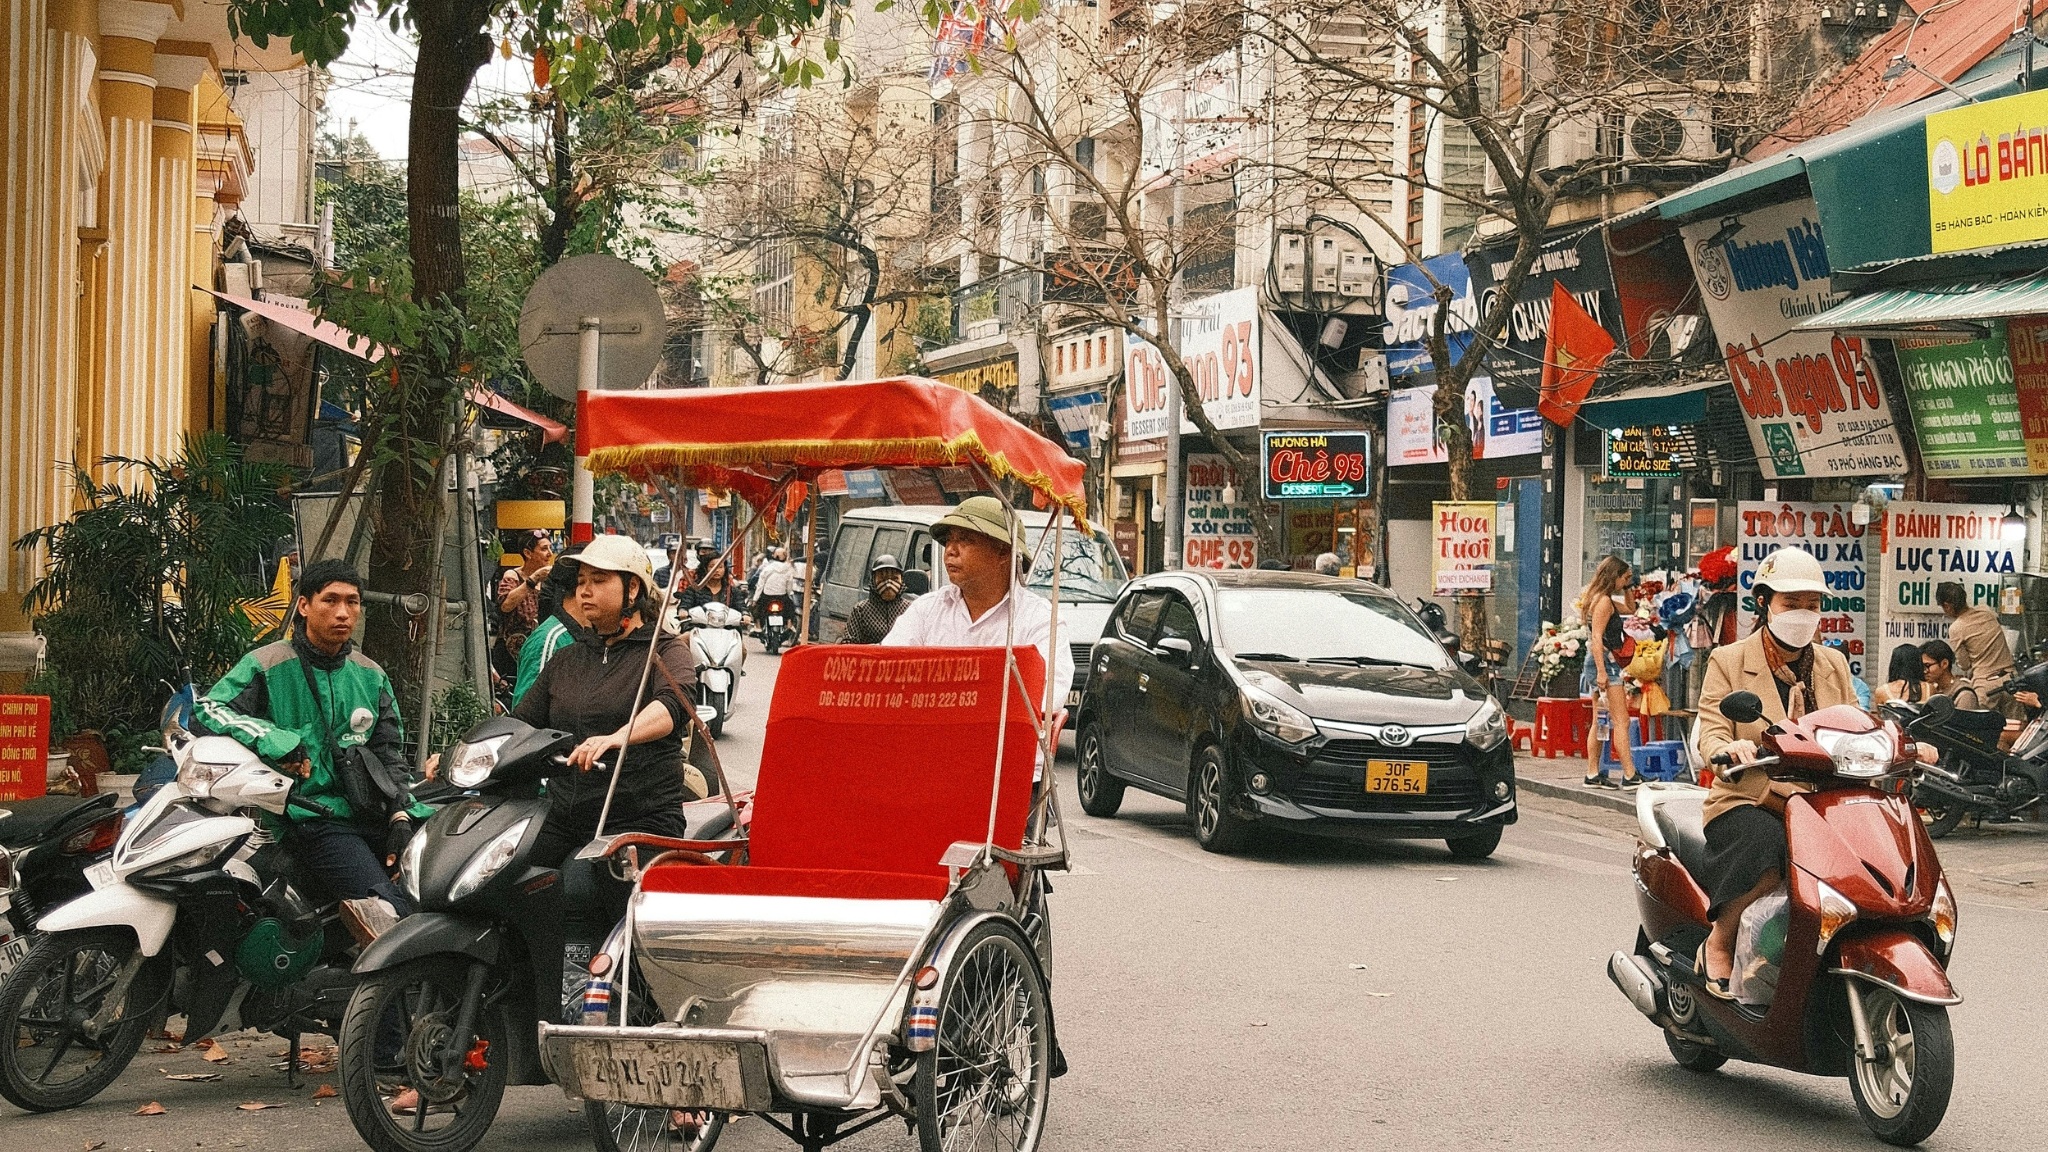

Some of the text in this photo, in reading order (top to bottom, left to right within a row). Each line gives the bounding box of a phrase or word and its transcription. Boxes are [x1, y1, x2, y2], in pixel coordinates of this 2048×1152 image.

[1963, 122, 2048, 187] LÒ BÁN
[1935, 221, 1947, 232] 95
[1948, 216, 1973, 230] HÀNG
[1975, 214, 1993, 228] BẠC
[1999, 207, 2027, 222] HOÀN
[1129, 347, 1166, 413] Chè
[1222, 320, 1254, 398] 93
[1906, 342, 2014, 391] CHÈ NGON PHỐ CỔ
[1726, 333, 1880, 434] Chè ngon 93
[1131, 416, 1169, 436] DESSERT SHO
[1270, 434, 1327, 448] HƯƠNG HẢI
[1612, 441, 1628, 453] KIM
[1189, 460, 1224, 487] TRÔI
[1270, 449, 1331, 483] Chè
[1334, 453, 1365, 481] 93
[1633, 456, 1651, 471] CÁC
[1652, 459, 1671, 471] SIZE
[1828, 454, 1903, 471] 93 PHỐ HÀNG BẠC
[1189, 489, 1211, 504] LỤC
[1281, 483, 1324, 495] DESSERT
[1187, 505, 1249, 519] CHÍ MÀ PH
[1439, 511, 1490, 534] Hoa
[1742, 503, 1866, 538] TRÔI TÀU
[1191, 519, 1218, 534] XÔI
[1895, 509, 2004, 540] BÁNH TRÔI TÀ
[1437, 537, 1491, 559] Tươi
[1612, 531, 1636, 549] LASER
[1793, 540, 1828, 562] ÀU
[1835, 540, 1864, 562] XÁ
[1186, 536, 1225, 568] CHÈ
[1228, 540, 1255, 569] 93
[1895, 545, 2016, 574] LỤC TÀU XÁ
[1438, 573, 1490, 585] MONEY EXCHANGE
[1823, 566, 1866, 591] PHÙ
[1898, 577, 2000, 609] CHÍ PH
[1917, 618, 1940, 639] TRÂN
[858, 658, 876, 683] TY
[875, 660, 896, 683] DU
[837, 691, 861, 707] 0912
[863, 692, 881, 708] 011
[885, 693, 903, 708] 140
[911, 692, 935, 708] 0913
[938, 692, 957, 708] 222
[959, 690, 978, 706] 633
[1385, 763, 1411, 776] 30F
[1373, 777, 1420, 792] 376.54
